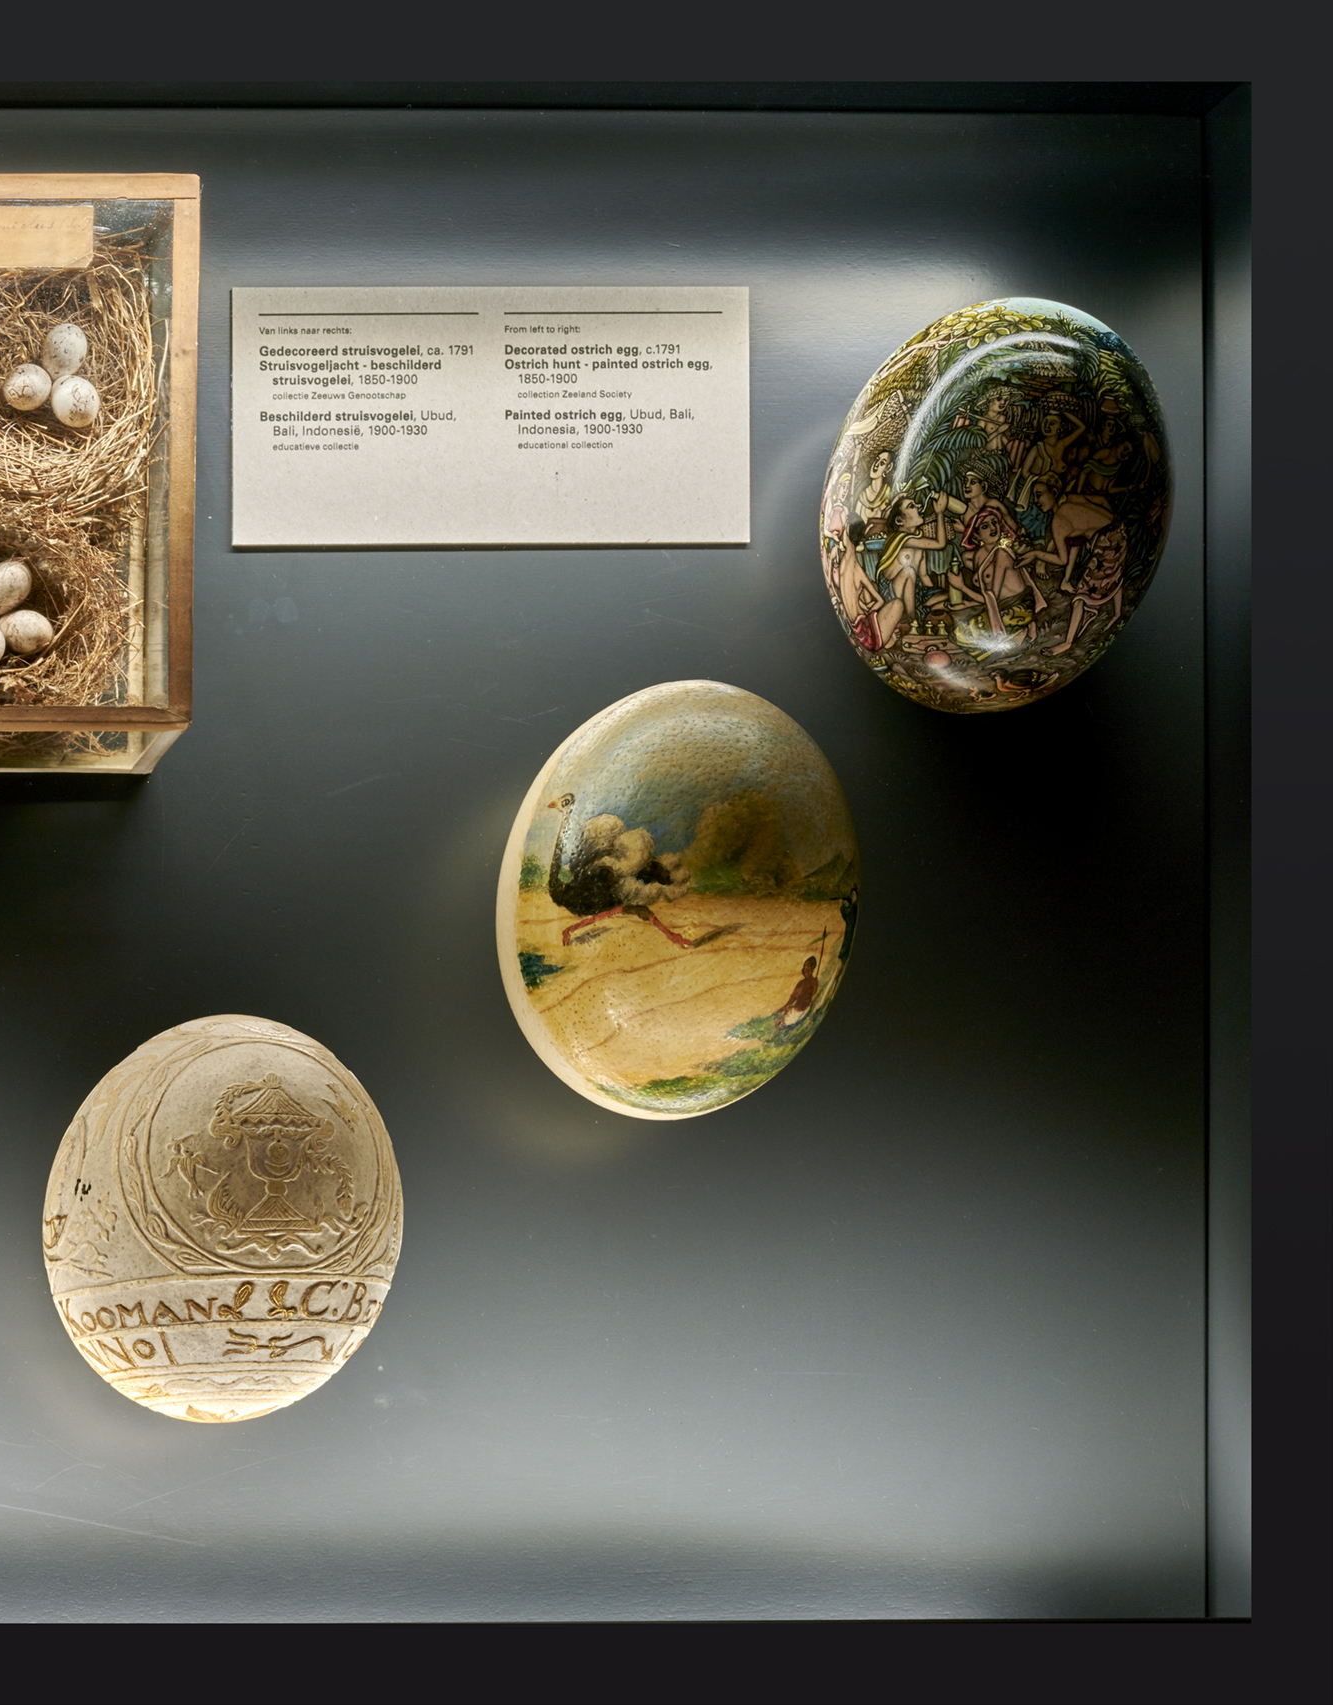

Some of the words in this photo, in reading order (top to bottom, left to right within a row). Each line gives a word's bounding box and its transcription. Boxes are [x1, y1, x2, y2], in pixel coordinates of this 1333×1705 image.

[259, 327, 275, 335] Van
[278, 327, 298, 335] links
[323, 326, 352, 335] rechts:
[504, 325, 527, 333] From
[530, 325, 544, 333] left
[546, 325, 555, 333] to
[557, 325, 581, 336] right:
[259, 345, 338, 357] Gedecoreerd
[342, 345, 423, 360] struisvogelei,
[427, 347, 444, 357] ca.
[449, 345, 474, 356] 1791
[505, 344, 567, 356] Decorated
[571, 344, 613, 356] ostrich
[617, 347, 642, 359] egg,
[646, 344, 681, 356] c.1791
[259, 359, 359, 373] Struisvogeljacht
[370, 359, 441, 371] beschilderd
[505, 359, 548, 370] Ostrich
[552, 359, 581, 370] hunt
[592, 358, 638, 373] painted
[642, 359, 684, 370] ostrich
[687, 361, 713, 373] egg,
[273, 374, 353, 388] struisvogelei,
[359, 374, 418, 385] 1850-1900
[518, 373, 577, 384] 1850-1900
[273, 392, 309, 400] collectie
[311, 392, 345, 400] Zeeuws
[348, 391, 406, 403] Genootschap
[518, 390, 559, 399] collection
[562, 390, 597, 399] Zeeland
[600, 390, 632, 401] Society
[260, 411, 331, 422] Beschilderd
[335, 411, 418, 425] struisvogelei,
[421, 410, 457, 425] Ubud,
[505, 410, 550, 421] Painted
[554, 409, 596, 421] ostrich
[600, 411, 626, 424] egg,
[629, 409, 666, 422] Ubud,
[670, 408, 695, 421] Bali,
[273, 426, 298, 439] Bali,
[302, 425, 364, 439] Indonesië,
[369, 425, 427, 436] 1900-1930
[518, 424, 579, 437] Indonesia,
[584, 424, 643, 435] 1900-1930
[273, 442, 320, 451] educatieve
[323, 442, 359, 451] collectie
[518, 441, 568, 449] educational
[571, 441, 613, 449] collection
